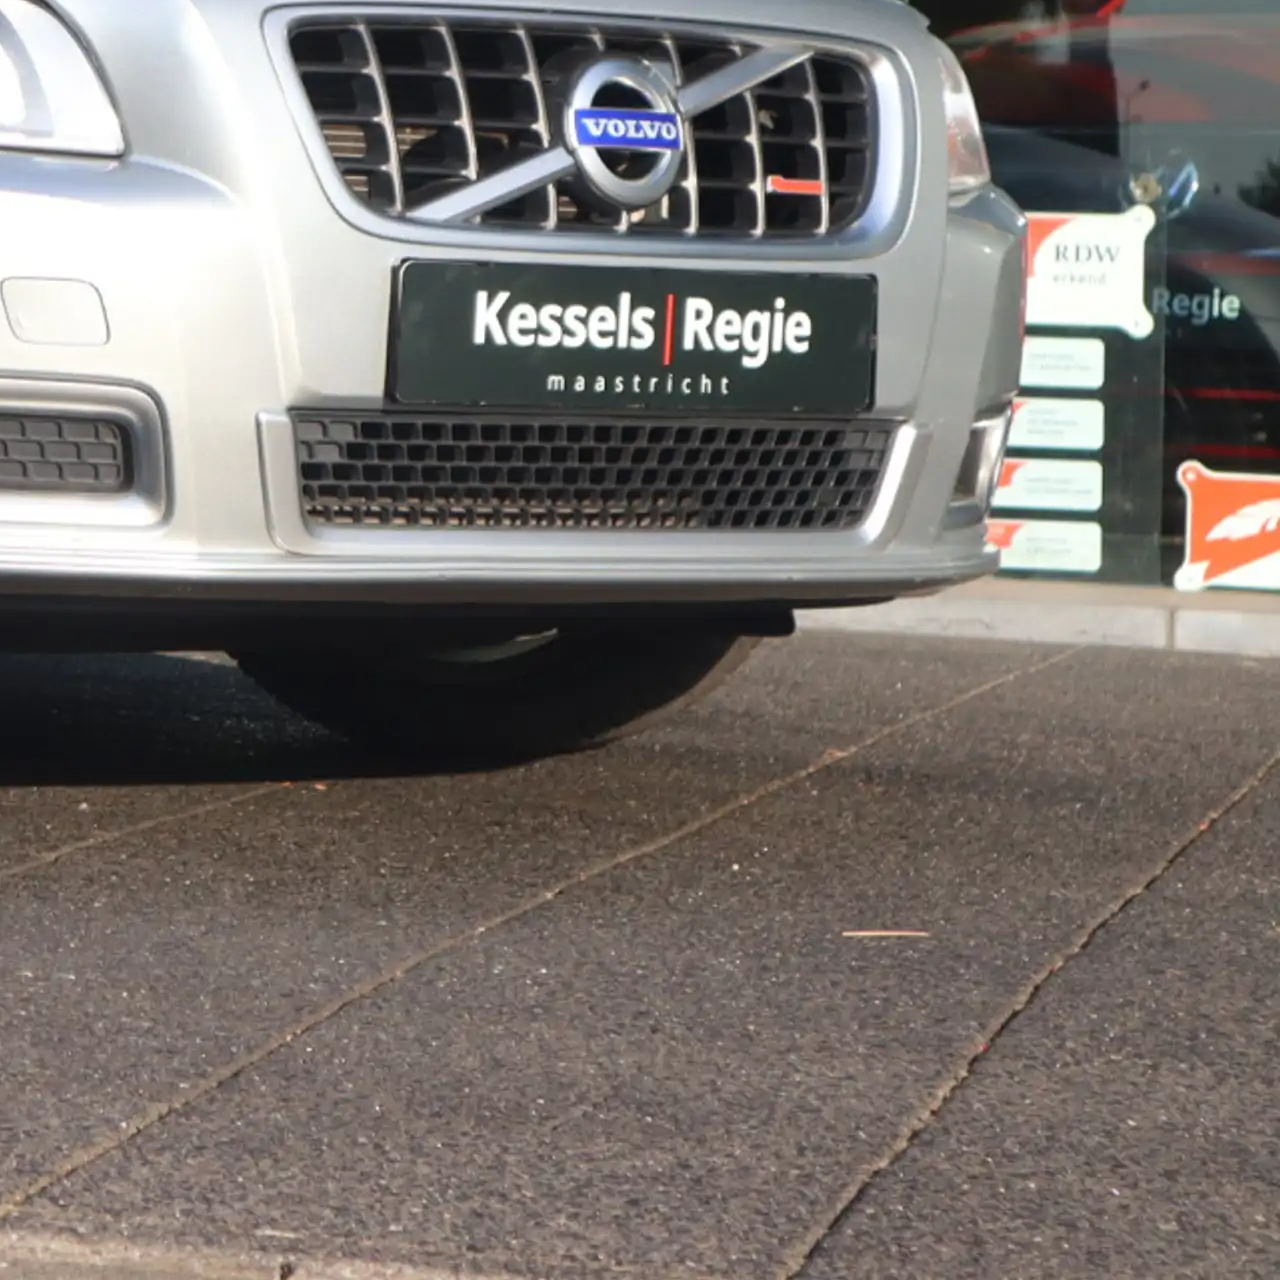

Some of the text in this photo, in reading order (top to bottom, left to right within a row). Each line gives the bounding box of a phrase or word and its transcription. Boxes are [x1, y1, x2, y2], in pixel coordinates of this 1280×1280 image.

[581, 117, 677, 140] VOLVO
[1053, 244, 1120, 263] RDW
[1151, 286, 1240, 327] Regie
[472, 290, 812, 369] Kessels Regie
[547, 372, 730, 395] maastricht
